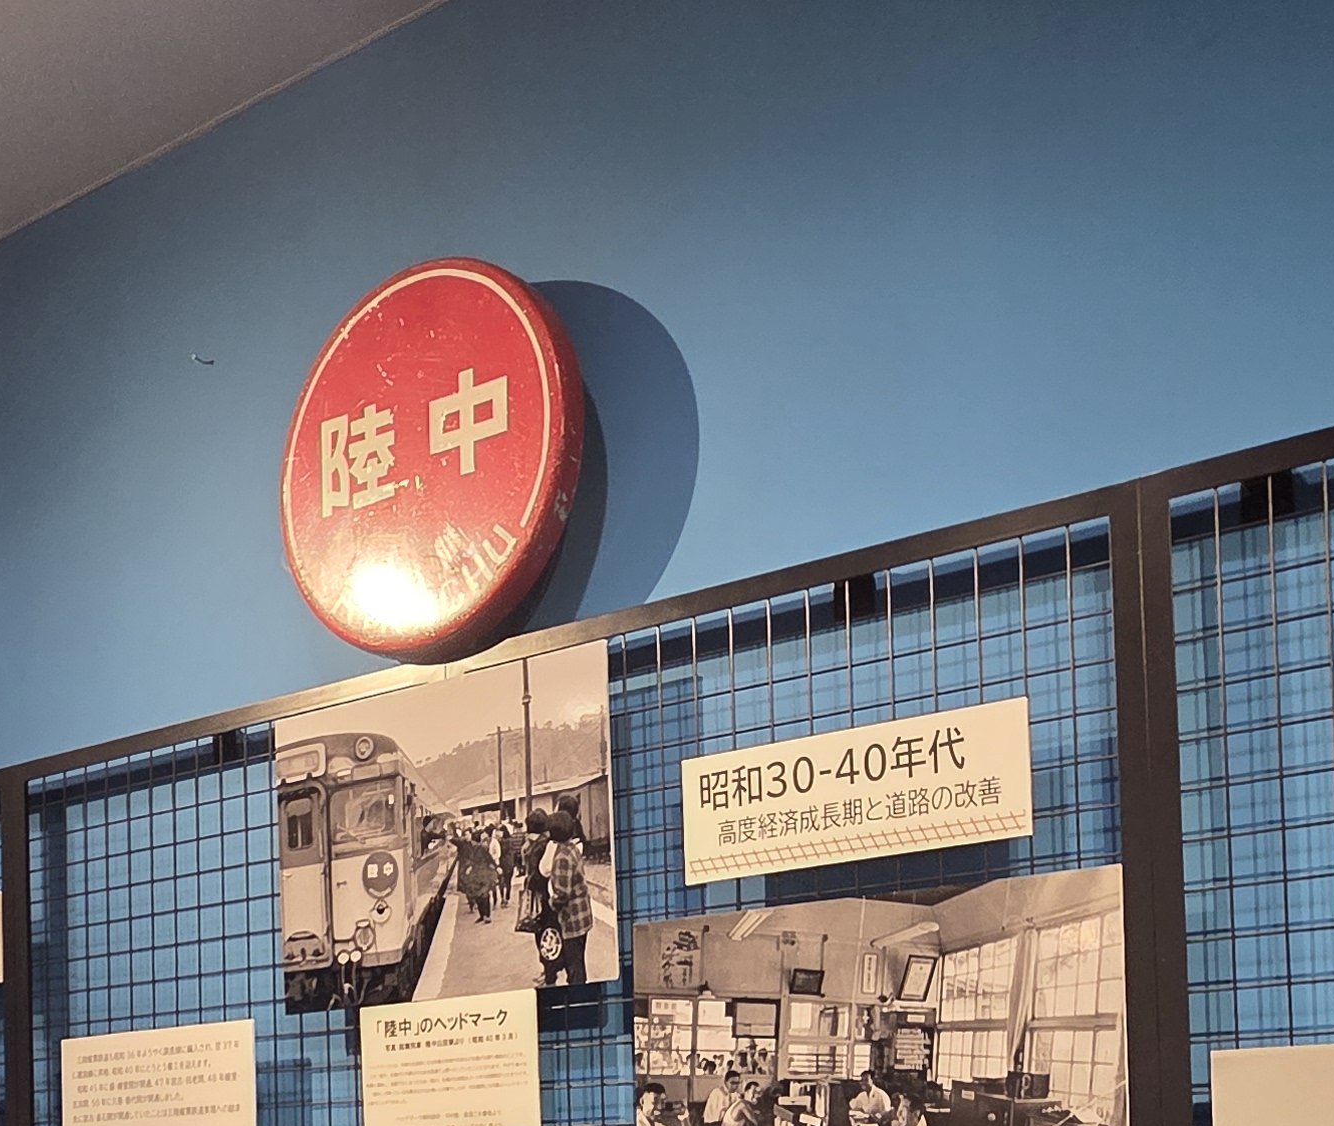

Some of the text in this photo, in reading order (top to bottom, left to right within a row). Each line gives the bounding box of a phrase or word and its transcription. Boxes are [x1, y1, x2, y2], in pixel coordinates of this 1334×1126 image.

[321, 368, 508, 518] 陸中
[698, 727, 966, 811] 昭和30-40年代
[717, 776, 1002, 847] 高度経済成長期と道路の改善
[376, 1009, 508, 1038] 「陸中」のヘッドマーク
